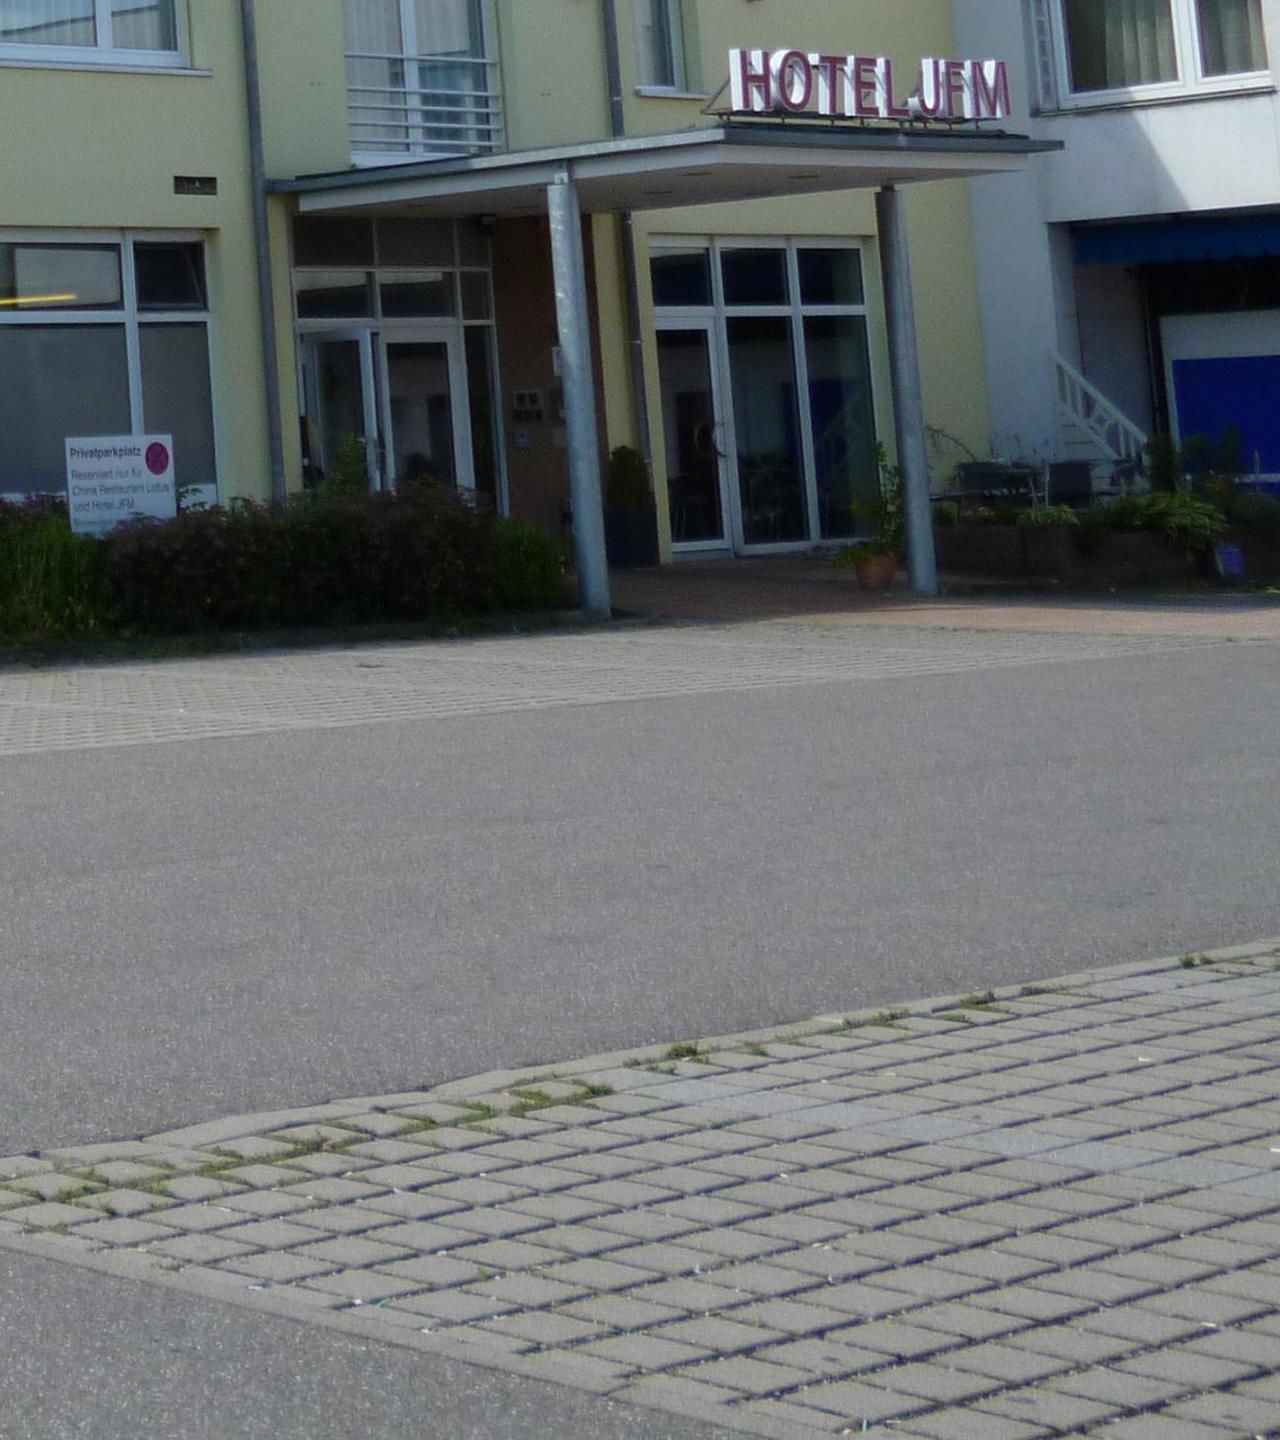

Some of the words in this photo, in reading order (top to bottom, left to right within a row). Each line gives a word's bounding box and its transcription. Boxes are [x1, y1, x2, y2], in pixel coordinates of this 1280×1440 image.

[731, 48, 909, 118] HOTEL
[913, 57, 1011, 119] JFM
[70, 446, 142, 459] Privatparkplatz
[71, 469, 113, 480] Reserviert
[115, 469, 129, 479] nur
[131, 468, 143, 478] für
[72, 485, 97, 496] China
[99, 484, 144, 495] Restaurant
[146, 482, 170, 493] Lotus
[73, 500, 90, 512] und
[92, 500, 114, 511] Hotel
